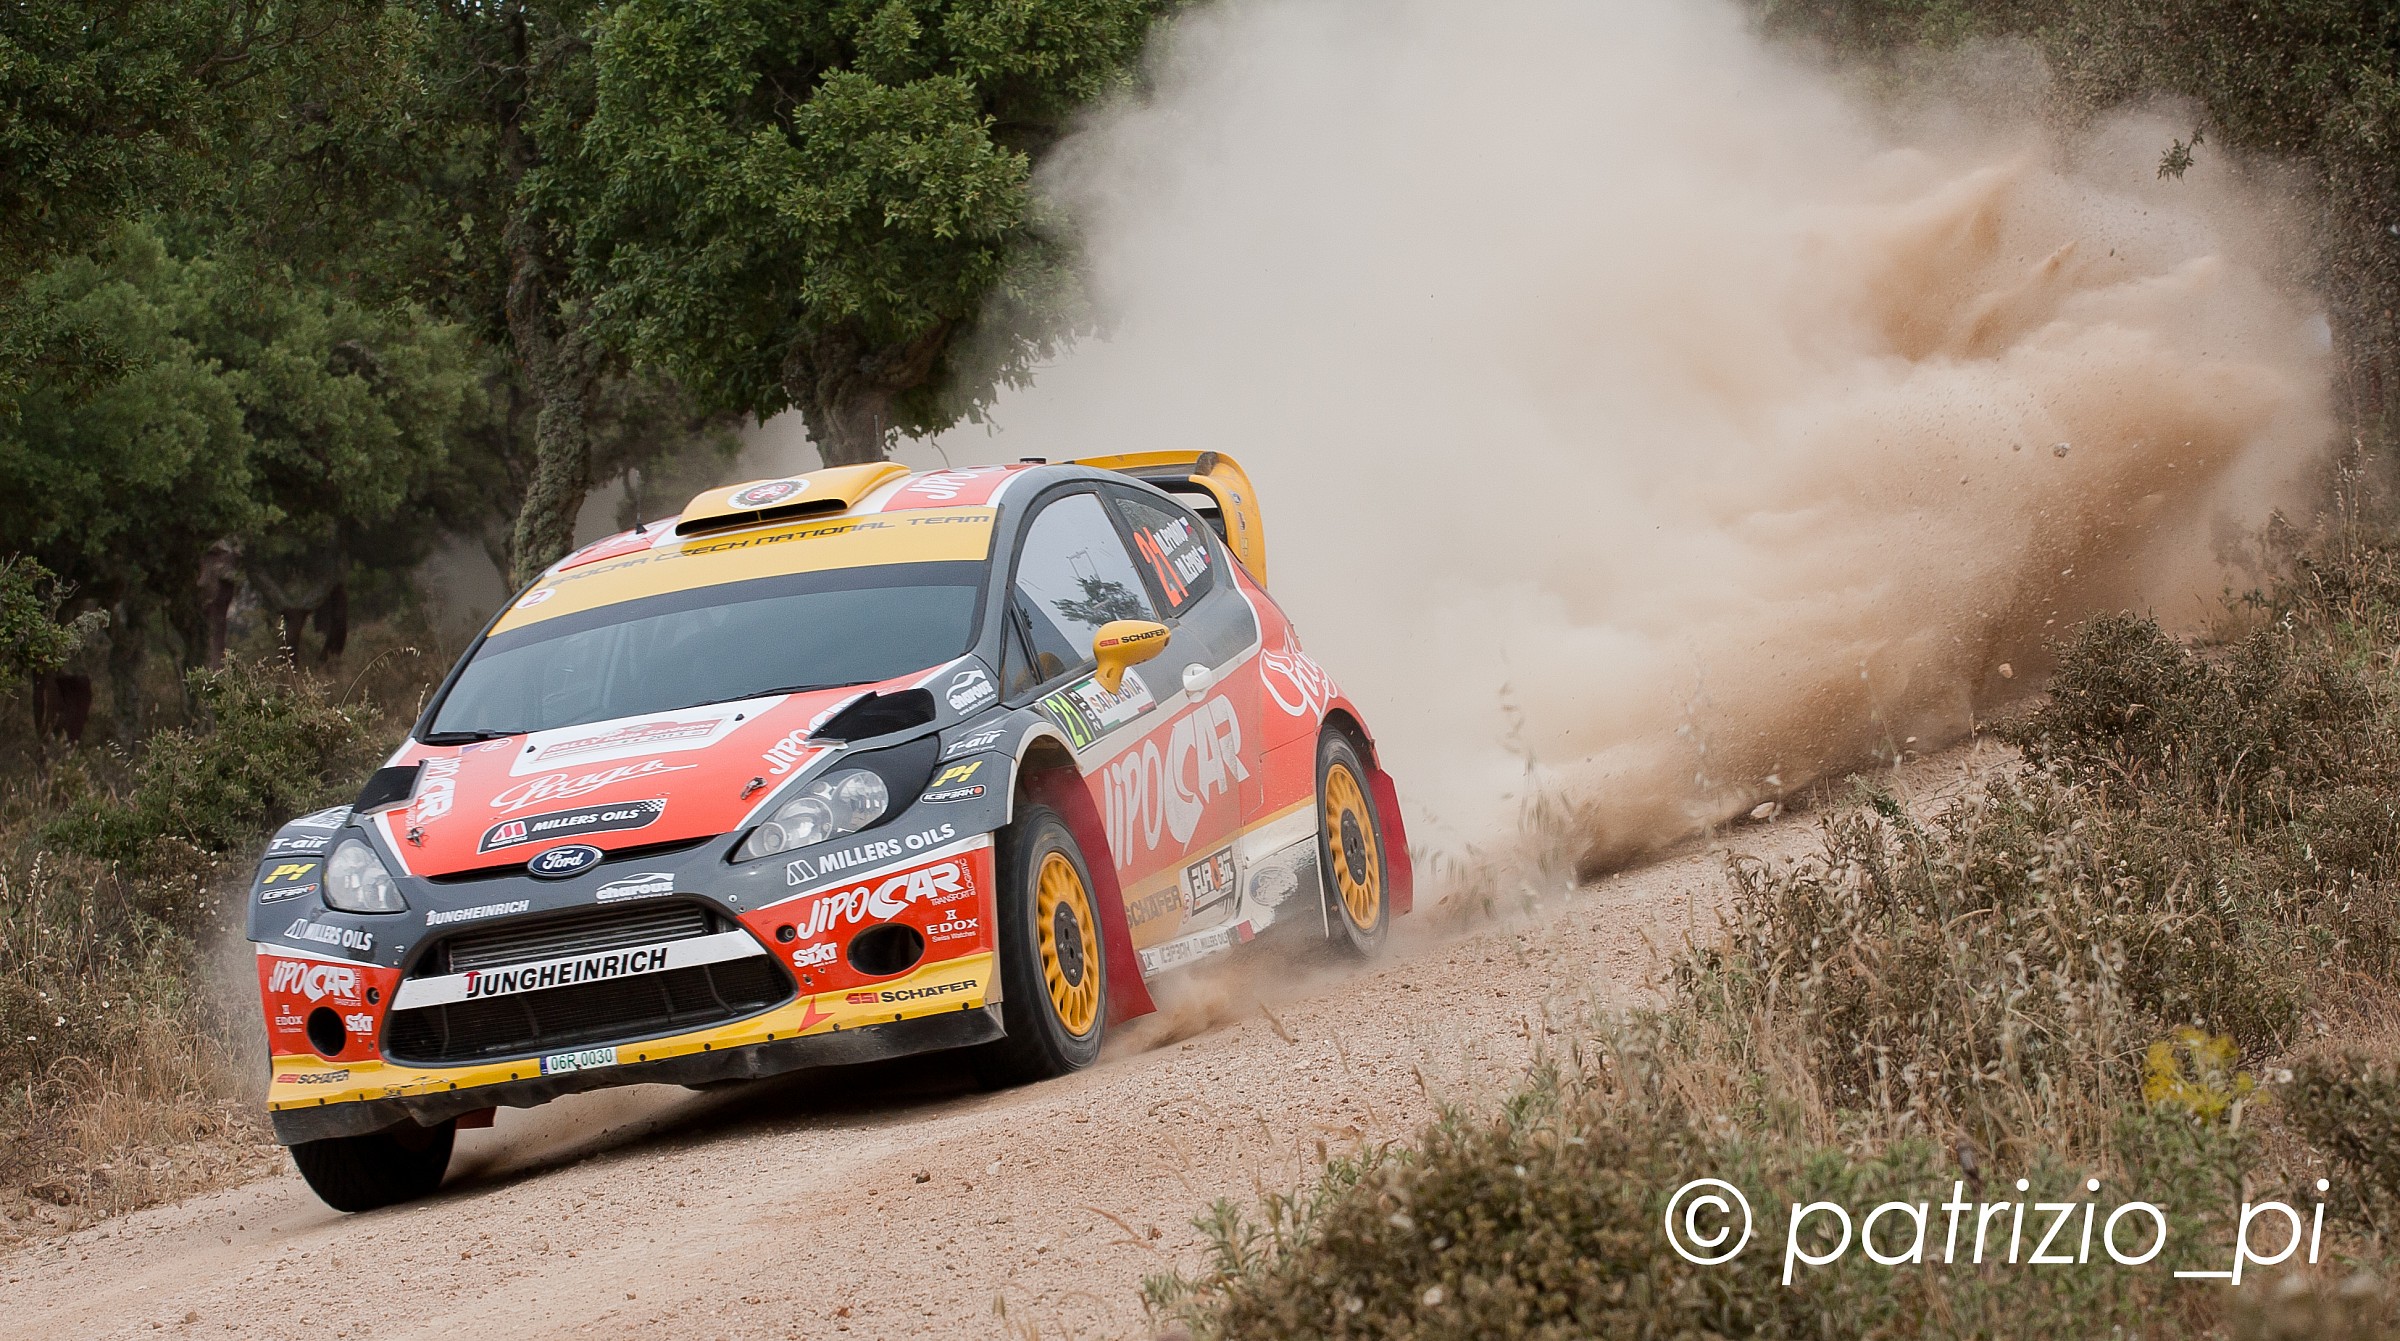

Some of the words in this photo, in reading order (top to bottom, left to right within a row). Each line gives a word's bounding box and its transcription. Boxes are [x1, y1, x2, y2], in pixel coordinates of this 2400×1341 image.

[655, 540, 749, 562] CZECH
[755, 521, 896, 547] NATIONAL
[906, 514, 990, 527] TEAM
[1133, 526, 1189, 608] 21
[1045, 693, 1092, 748] 21
[531, 813, 599, 833] MILLERS
[600, 809, 641, 822] OILS
[271, 837, 329, 850] T-air
[819, 838, 903, 875] MILLERS
[904, 823, 956, 850] OILS
[542, 849, 585, 870] Ford
[595, 881, 674, 900] charouz
[426, 899, 530, 926] JUNGHEINRICH
[926, 917, 980, 935] EDOX
[341, 929, 374, 951] OILS
[466, 948, 668, 999] JUNGHEINRICH
[275, 1015, 304, 1026] EDOX
[551, 1055, 577, 1071] 06R
[580, 1048, 613, 1066] 0030
